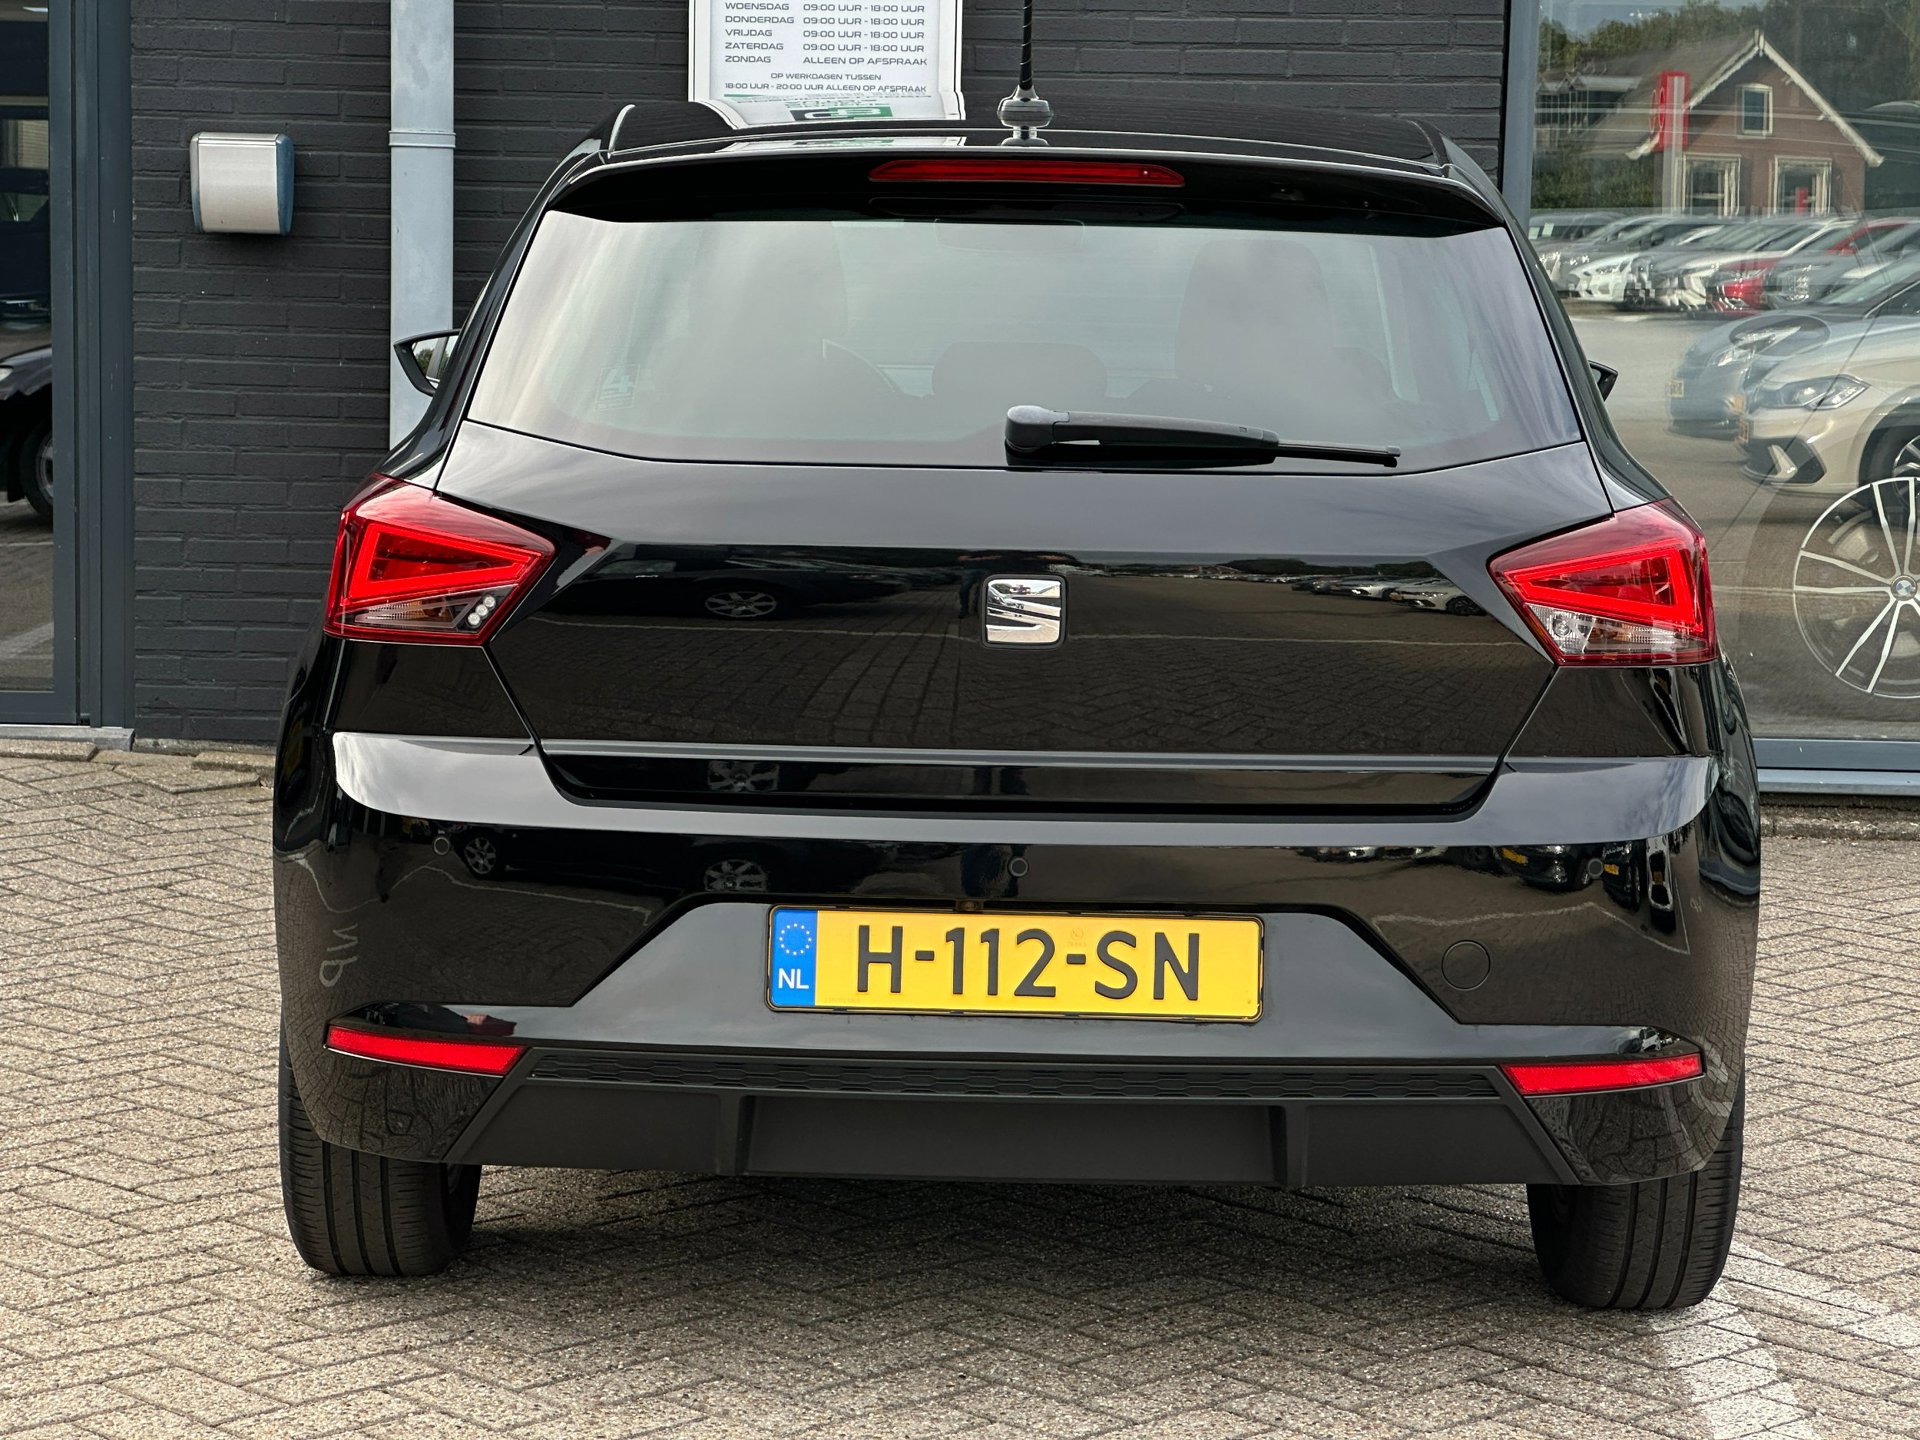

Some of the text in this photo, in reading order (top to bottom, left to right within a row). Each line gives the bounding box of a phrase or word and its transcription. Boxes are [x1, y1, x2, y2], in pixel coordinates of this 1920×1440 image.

[725, 2, 789, 10] WOENSDAG
[725, 16, 794, 24] DONDERDAG
[725, 42, 783, 50] ZATERDAG
[725, 55, 771, 63] ZONDAG
[878, 85, 926, 93] AFSPRAAK
[857, 925, 1200, 1001] H-112-SN
[778, 968, 809, 990] NL
